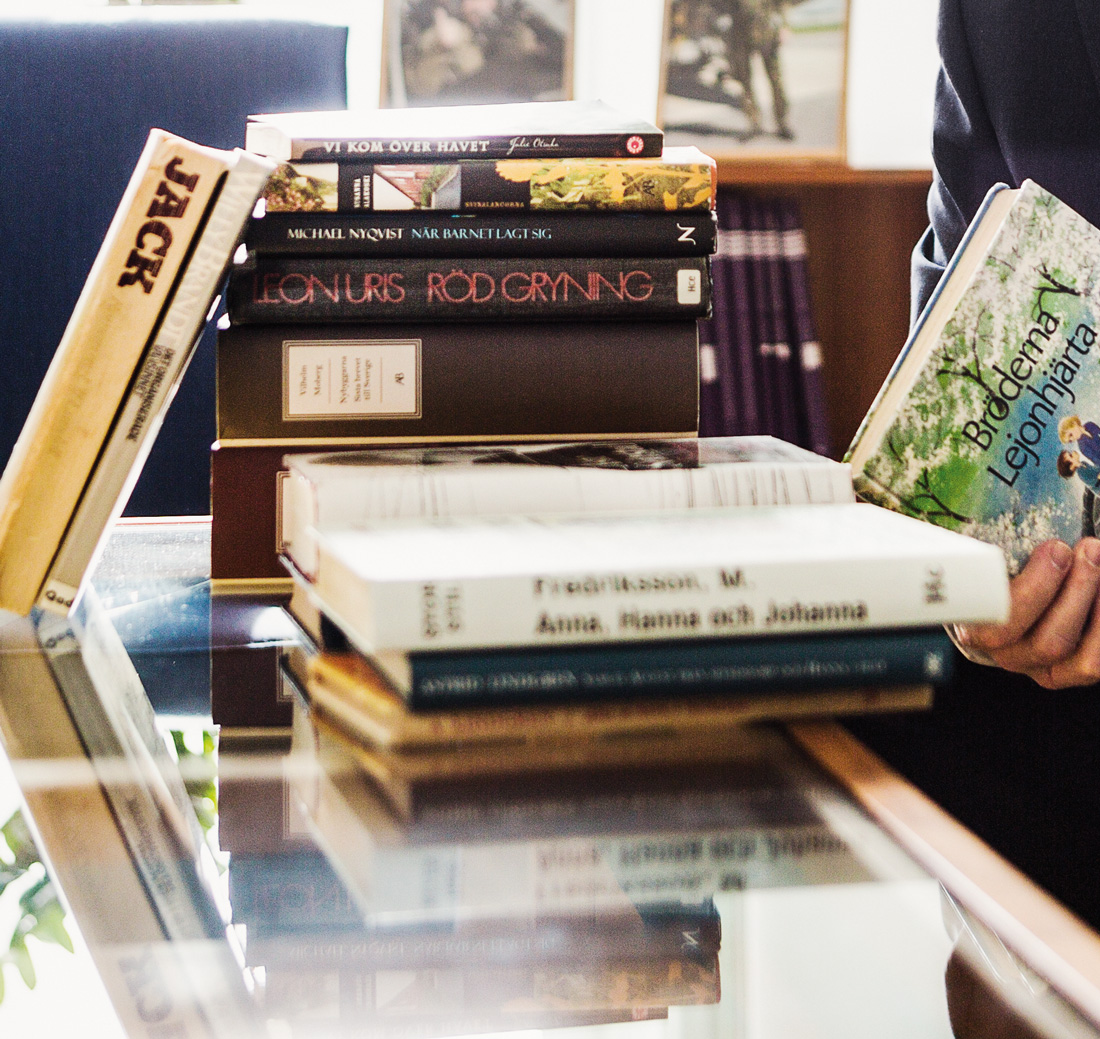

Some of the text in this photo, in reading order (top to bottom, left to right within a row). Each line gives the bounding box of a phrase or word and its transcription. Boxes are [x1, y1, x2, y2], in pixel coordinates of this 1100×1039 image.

[324, 138, 490, 153] VI KOM ÖVER HAVET
[117, 156, 200, 295] JACK
[287, 226, 552, 241] MICHAEL NYQVIST NÄR BARNET LAGT SIG
[253, 272, 406, 304] LEON URIS
[427, 269, 654, 303] RÖD GRYNING
[962, 311, 1060, 451] Bröderna
[987, 323, 1098, 487] Lejonhjärta
[536, 598, 868, 637] Anna, Hanna och Johanna
